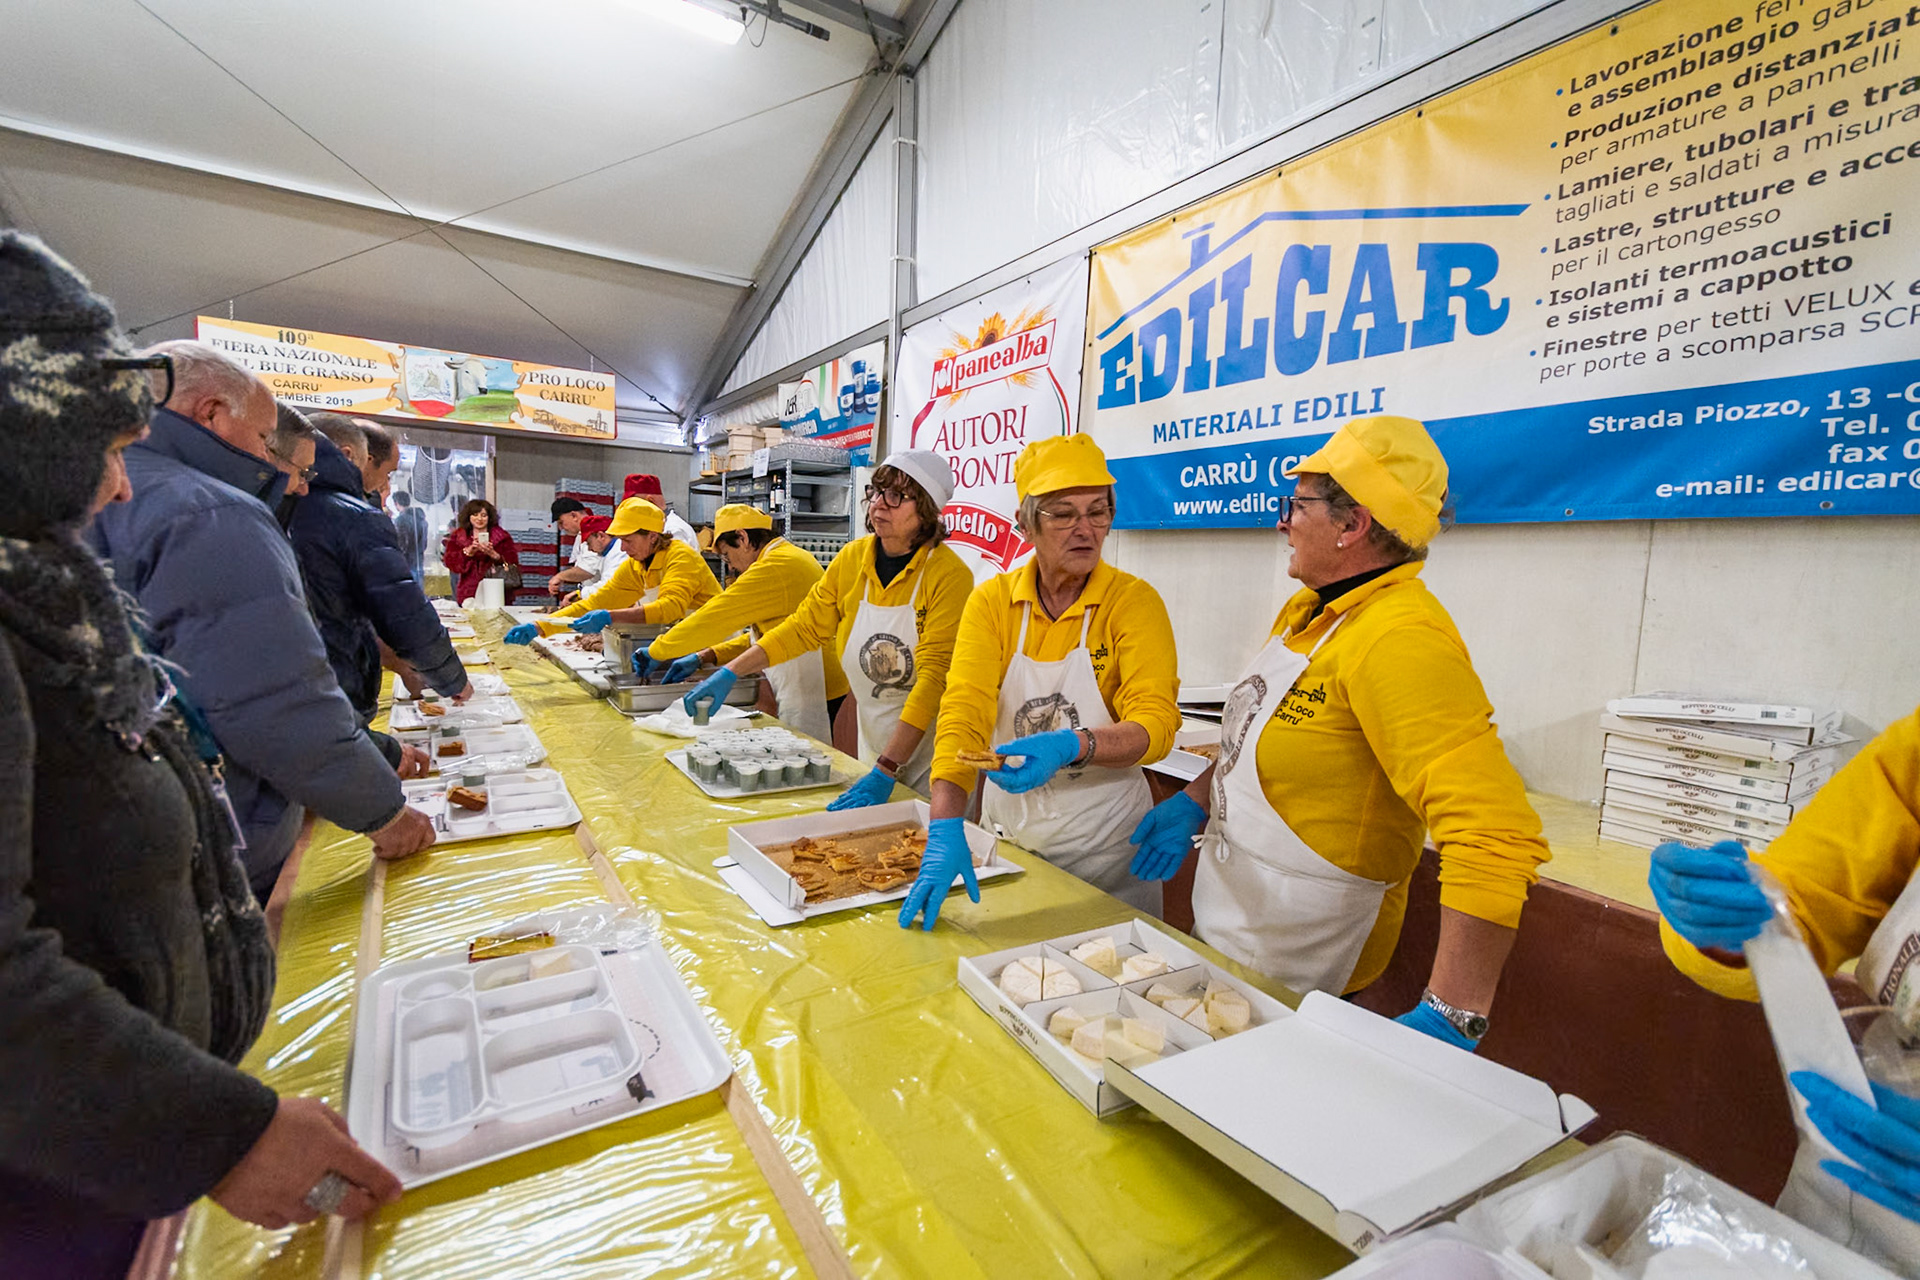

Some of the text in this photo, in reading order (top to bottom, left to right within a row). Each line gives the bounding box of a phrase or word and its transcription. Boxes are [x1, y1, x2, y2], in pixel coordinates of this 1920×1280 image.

[1564, 6, 1920, 148] Produzione distanziat
[1567, 101, 1582, 118] e
[1590, 20, 1799, 110] assemblaggio
[1570, 16, 1743, 95] Lavorazione
[1560, 39, 1901, 173] per armature a pannelli
[1556, 103, 1920, 223] tagliati e saldati a misura
[1558, 157, 1673, 200] Lamiere,
[1685, 105, 1815, 161] tubolari
[1828, 98, 1849, 118] e
[1554, 141, 1920, 254] Lastre, strutture e acce
[1548, 213, 1892, 306] Isolanti termoacustici
[1552, 206, 1781, 281] per il cartongesso
[1543, 326, 1647, 358] Finestre
[1657, 317, 1700, 343] per
[1711, 301, 1771, 330] tetti
[1785, 280, 1895, 318] VELUX
[1546, 253, 1854, 329] e sistemi a cappotto
[211, 338, 269, 356] FIERA
[273, 345, 377, 369] NAZIONALE
[1097, 242, 1510, 411] EDILCAR
[1539, 363, 1576, 384] per
[1583, 347, 1646, 377] porte
[1656, 346, 1670, 362] a
[1682, 321, 1845, 358] scomparsa
[260, 360, 297, 374] BUE
[302, 365, 374, 384] GRASSO
[529, 371, 606, 392] PRO LOCO
[954, 333, 1048, 390] panealba
[932, 404, 1029, 452] AUTORI
[1153, 387, 1386, 444] MATERIALI EDILI
[1587, 411, 1683, 435] Strada
[1695, 399, 1811, 425] Piozzo,
[1825, 386, 1871, 411] 13
[1820, 413, 1890, 437] Tel.
[948, 446, 1021, 488] BONT
[1180, 452, 1309, 488] CARRÙ (C
[1828, 443, 1889, 464] fax
[1656, 474, 1765, 497] e-mail:
